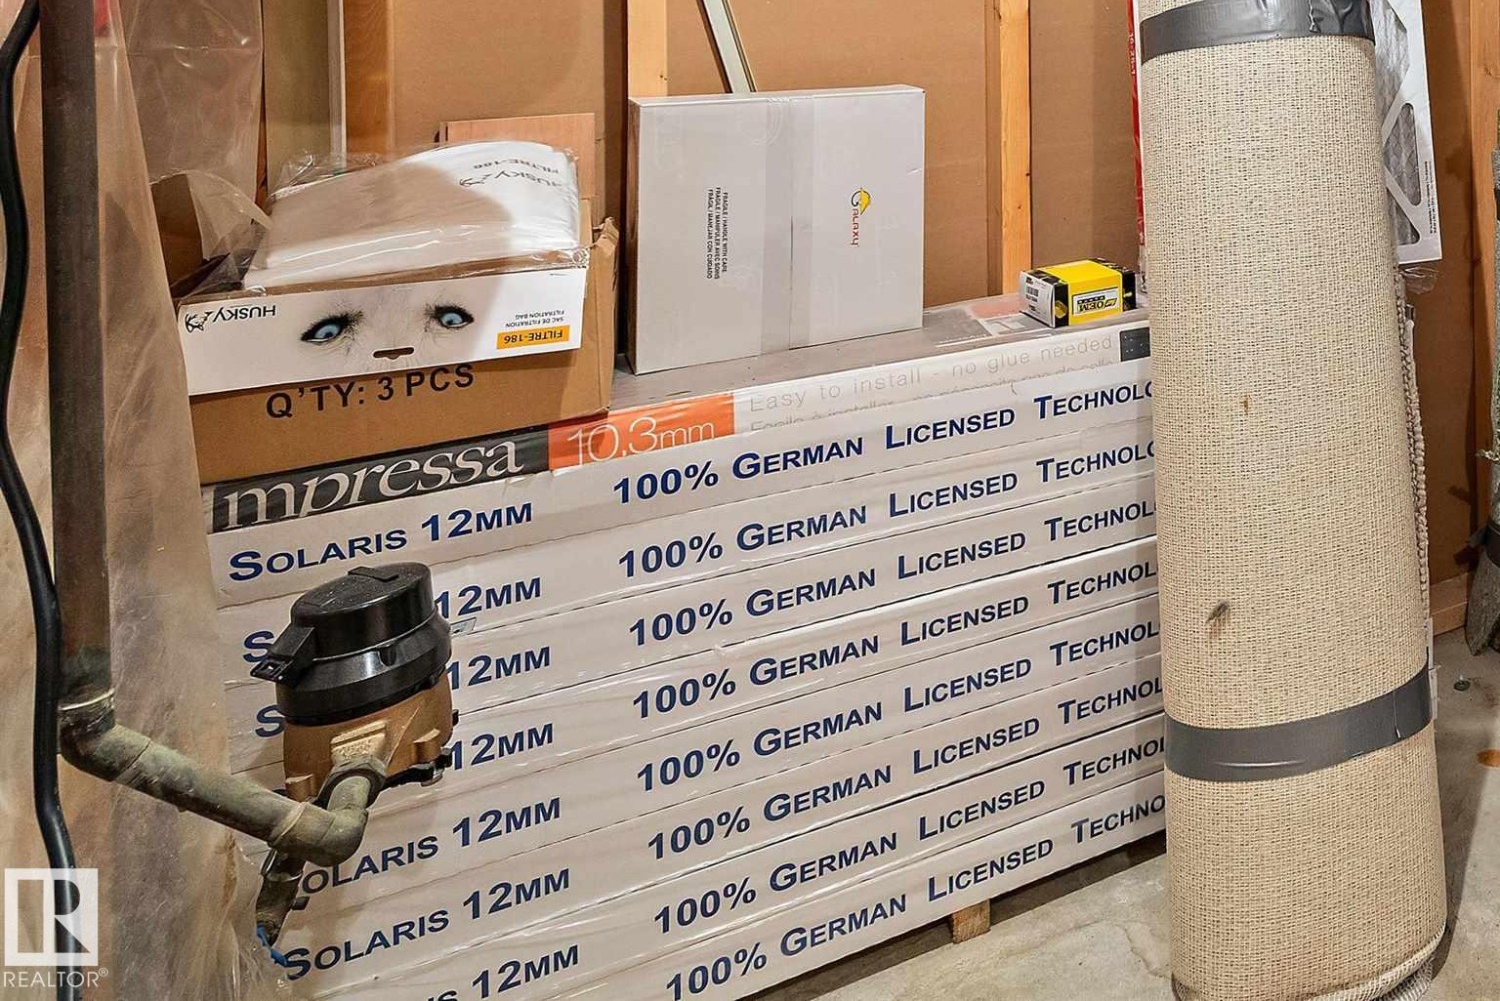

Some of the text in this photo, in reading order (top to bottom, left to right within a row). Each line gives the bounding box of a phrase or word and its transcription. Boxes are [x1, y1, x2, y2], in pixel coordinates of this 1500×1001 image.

[211, 304, 276, 324] HUSKY
[503, 329, 563, 344] FILTRE-186
[377, 376, 394, 402] 3
[404, 363, 475, 398] PCS
[750, 338, 1112, 413] Easy to install no glue needed
[614, 461, 718, 503] 100%
[733, 437, 862, 478] GERMAN
[887, 409, 1014, 449] LICENSED
[1034, 381, 1152, 419] TECHNOL
[229, 503, 531, 582] SOLARIS 12MM
[619, 441, 1154, 577] 100% GERMAN LICENSED TECHNOL
[435, 578, 540, 618] 12MM
[630, 501, 1154, 645] 100% GERMAN LICENSED TECHNOL
[447, 646, 550, 690] 12MM
[634, 562, 1157, 718] 100% GERMAN LICENSED TECHNOL
[450, 723, 553, 770] 12MM
[638, 621, 1159, 791] 100% GERMAN LICENSED TECHNOL
[649, 677, 1163, 860] 100% GERMAN LICENSED TECHNOL
[302, 798, 559, 894] OLARIS 12MM
[655, 736, 1164, 933] 100% GERMAN LICENSED TECHNO
[283, 869, 568, 980] SOLARIS 12MM
[667, 798, 1165, 1001] 100% GERMAN LICENSED TECHNO
[473, 945, 578, 998] 12MM
